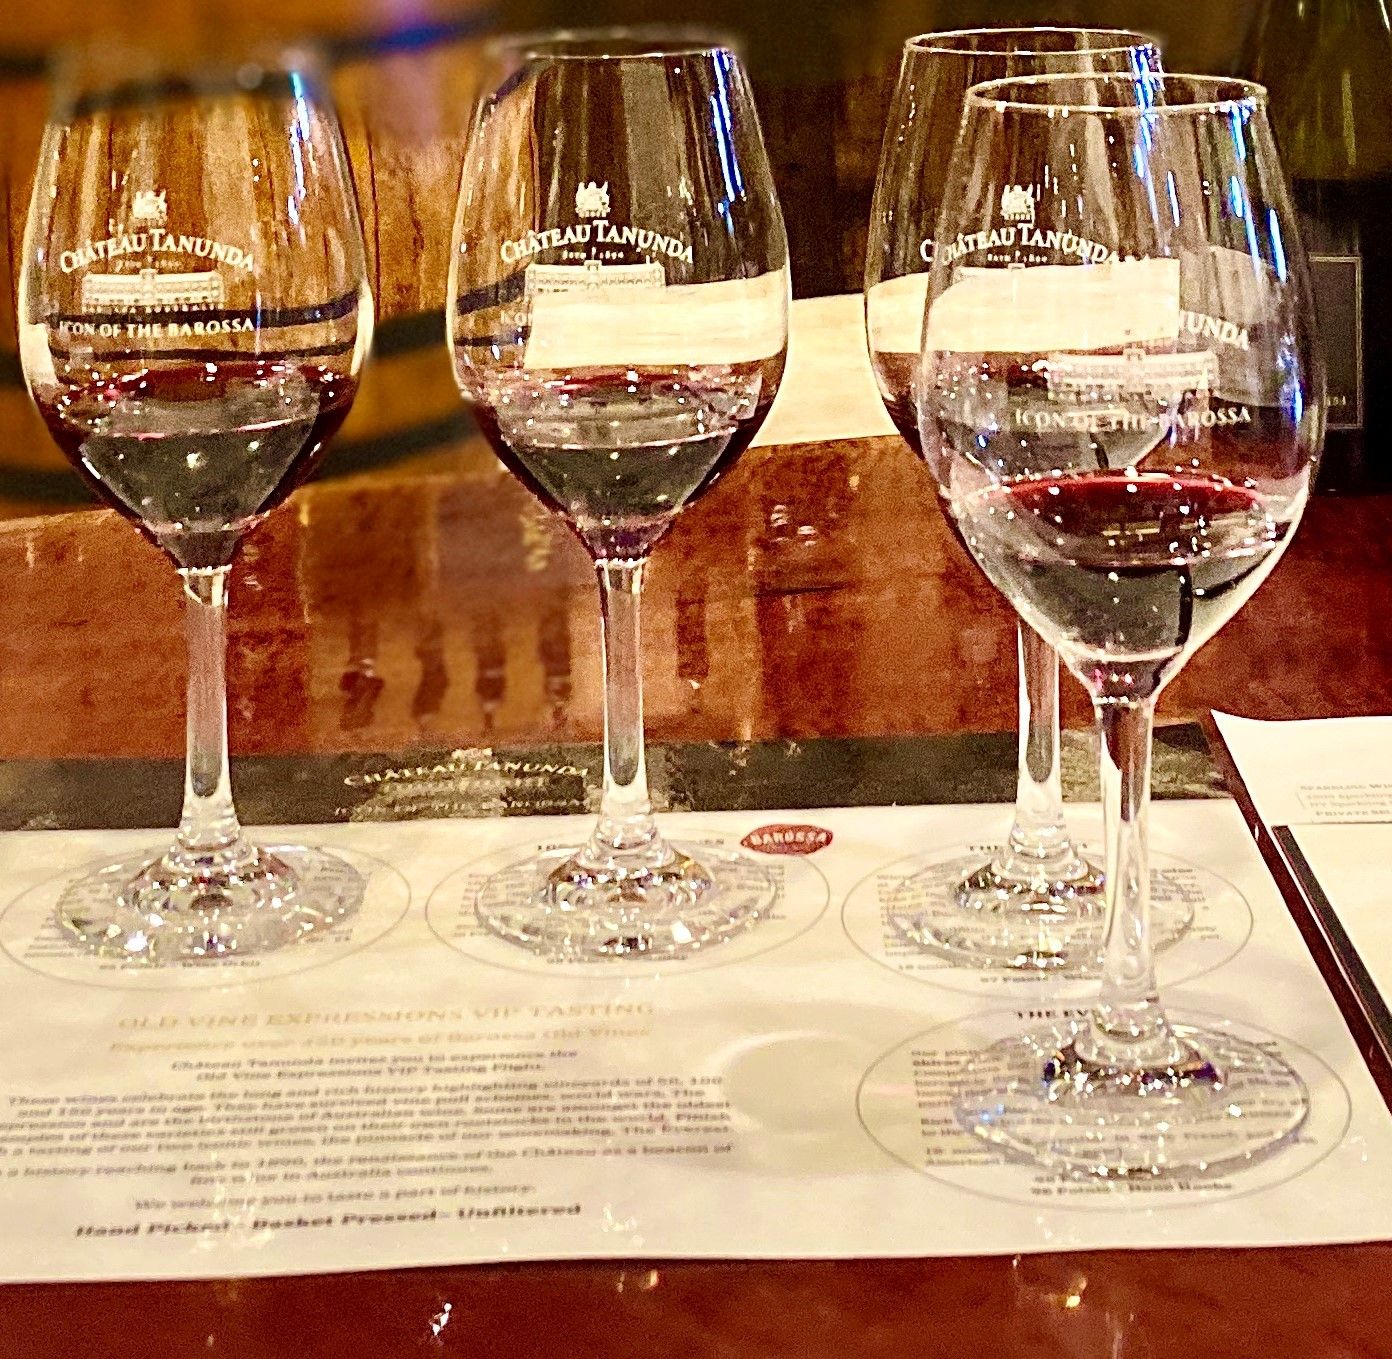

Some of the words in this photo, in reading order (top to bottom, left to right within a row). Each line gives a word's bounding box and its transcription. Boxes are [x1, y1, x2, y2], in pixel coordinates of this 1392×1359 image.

[149, 228, 256, 272] TANUNDA
[592, 219, 694, 264] TANUNDA
[59, 320, 96, 336] ICON
[99, 323, 121, 338] OF
[126, 323, 163, 339] THE
[166, 317, 255, 337] BAROSSA
[750, 829, 827, 846] BAROSSA
[118, 1013, 178, 1029] OLD
[189, 1011, 257, 1027] VINE
[266, 1008, 462, 1026] EXPRESSIONS
[473, 1006, 521, 1020] VIP
[533, 1002, 653, 1018] TASTING
[75, 1223, 140, 1239] Hand
[147, 1219, 230, 1236] Picked
[252, 1212, 333, 1230] Basket
[340, 1207, 437, 1227] Pressed
[458, 1201, 582, 1220] Unfiltered
